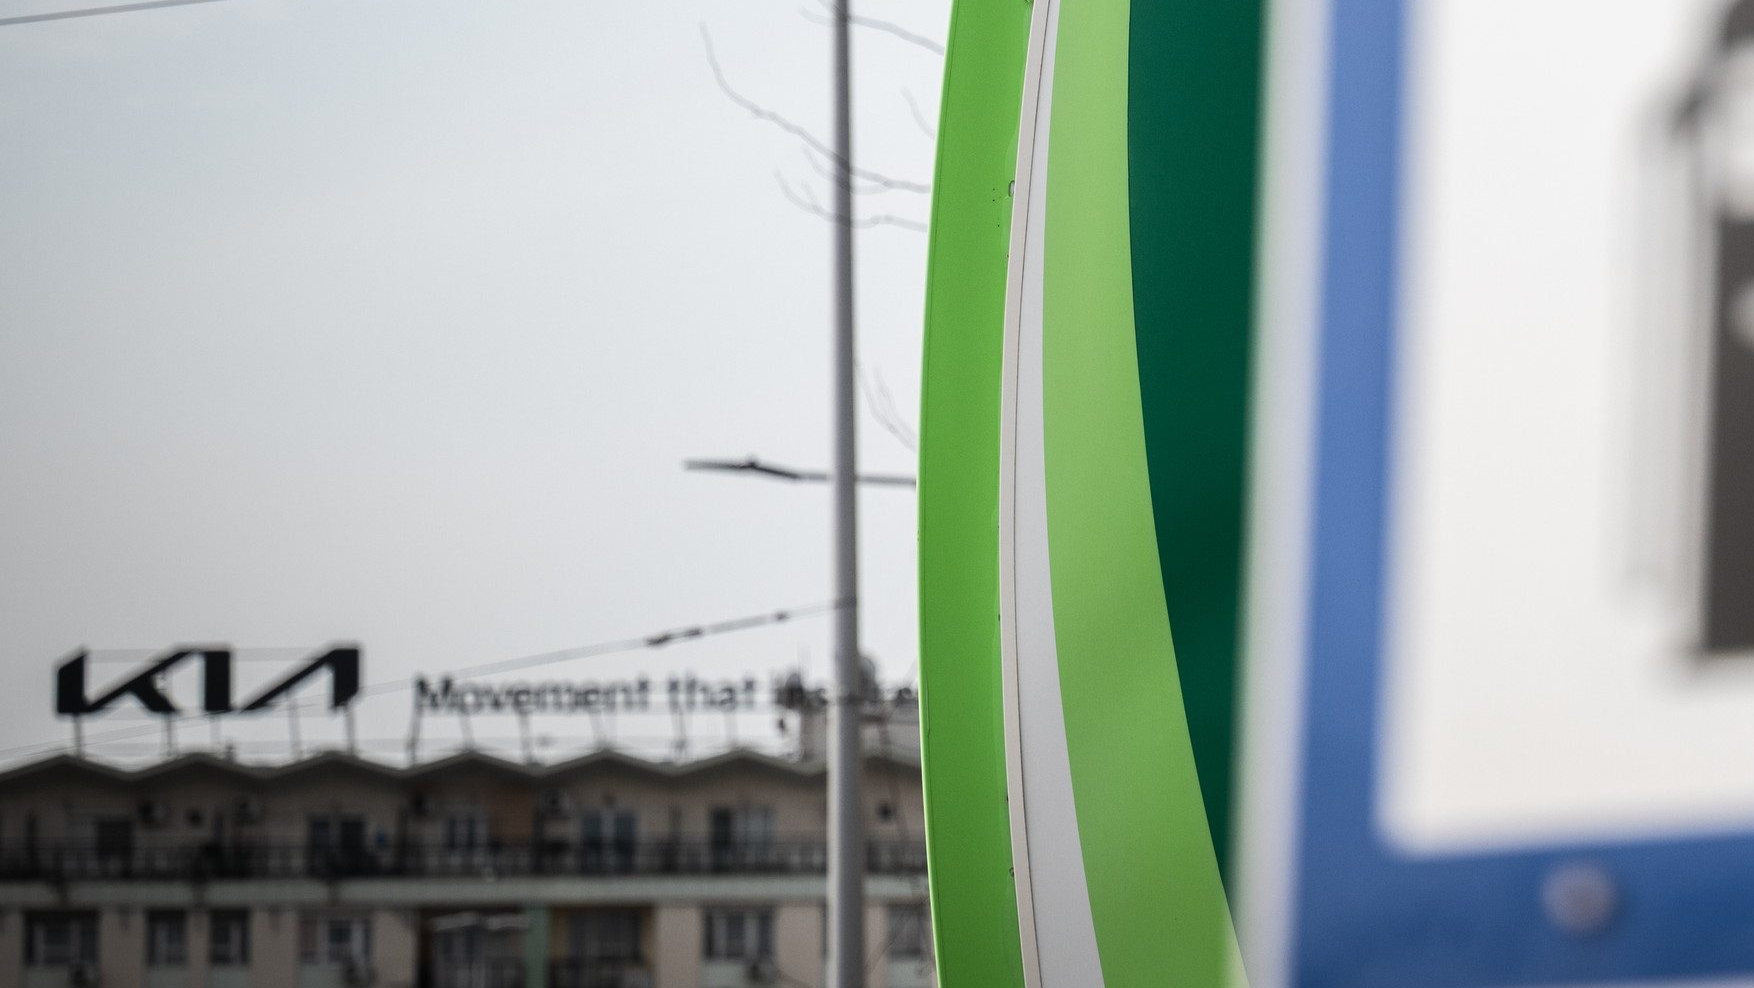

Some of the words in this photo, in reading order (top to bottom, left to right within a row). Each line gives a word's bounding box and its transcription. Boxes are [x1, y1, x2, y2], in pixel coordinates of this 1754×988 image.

[56, 646, 359, 714] KIA
[414, 675, 650, 712] Movement
[667, 675, 755, 710] that
